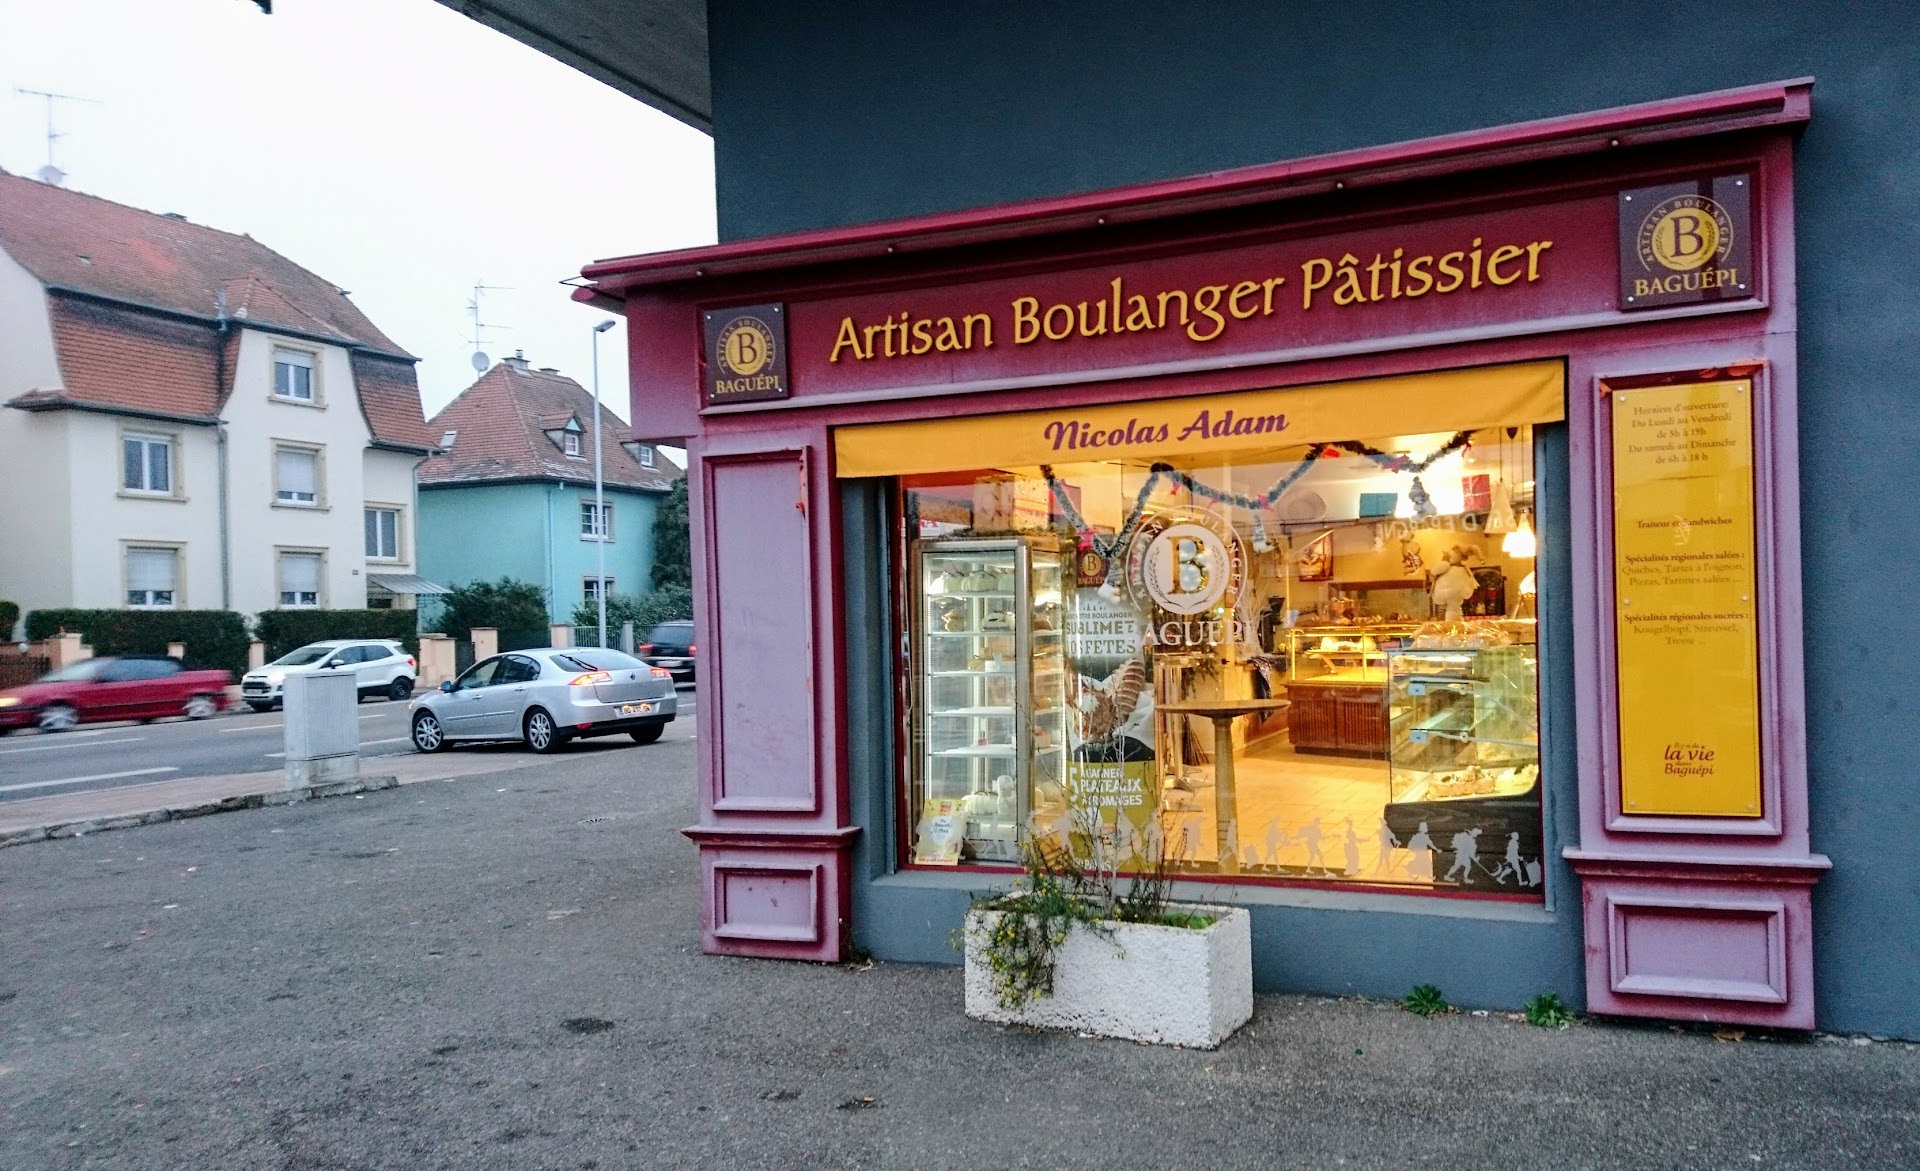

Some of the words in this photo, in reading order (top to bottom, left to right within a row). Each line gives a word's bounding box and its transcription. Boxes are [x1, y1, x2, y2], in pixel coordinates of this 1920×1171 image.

[1670, 215, 1704, 258] B
[1634, 266, 1738, 297] BAGUÉPI
[829, 311, 993, 362] Artisan
[1013, 276, 1286, 341] Boulanger
[1300, 237, 1553, 310] Pâtissier
[736, 332, 757, 365] B
[715, 373, 780, 394] BAGUÉPI
[1633, 404, 1672, 416] Horaires
[1631, 419, 1646, 428] Du
[1649, 416, 1675, 427] Lundi
[1677, 417, 1688, 425] au
[1690, 412, 1732, 423] Vendredi
[1044, 418, 1169, 450] Nicolas
[1177, 409, 1290, 441] Adam
[1656, 429, 1667, 439] de
[1628, 444, 1643, 454] Du
[1645, 442, 1675, 452] samedi
[1690, 437, 1737, 449] Dimanche
[1655, 455, 1666, 464] de
[1637, 520, 1670, 529] Traiteur
[1087, 555, 1097, 571] B
[1166, 535, 1210, 595] B
[1625, 553, 1669, 565] Spécialités
[1671, 551, 1714, 563] régionales
[1092, 611, 1133, 619] BOULANGER
[1624, 613, 1668, 624] Spécialités
[1669, 611, 1712, 623] régionales
[1664, 744, 1684, 761] la
[1688, 745, 1715, 761] vie
[1664, 763, 1715, 777] Baguépi
[1070, 767, 1079, 802] 5
